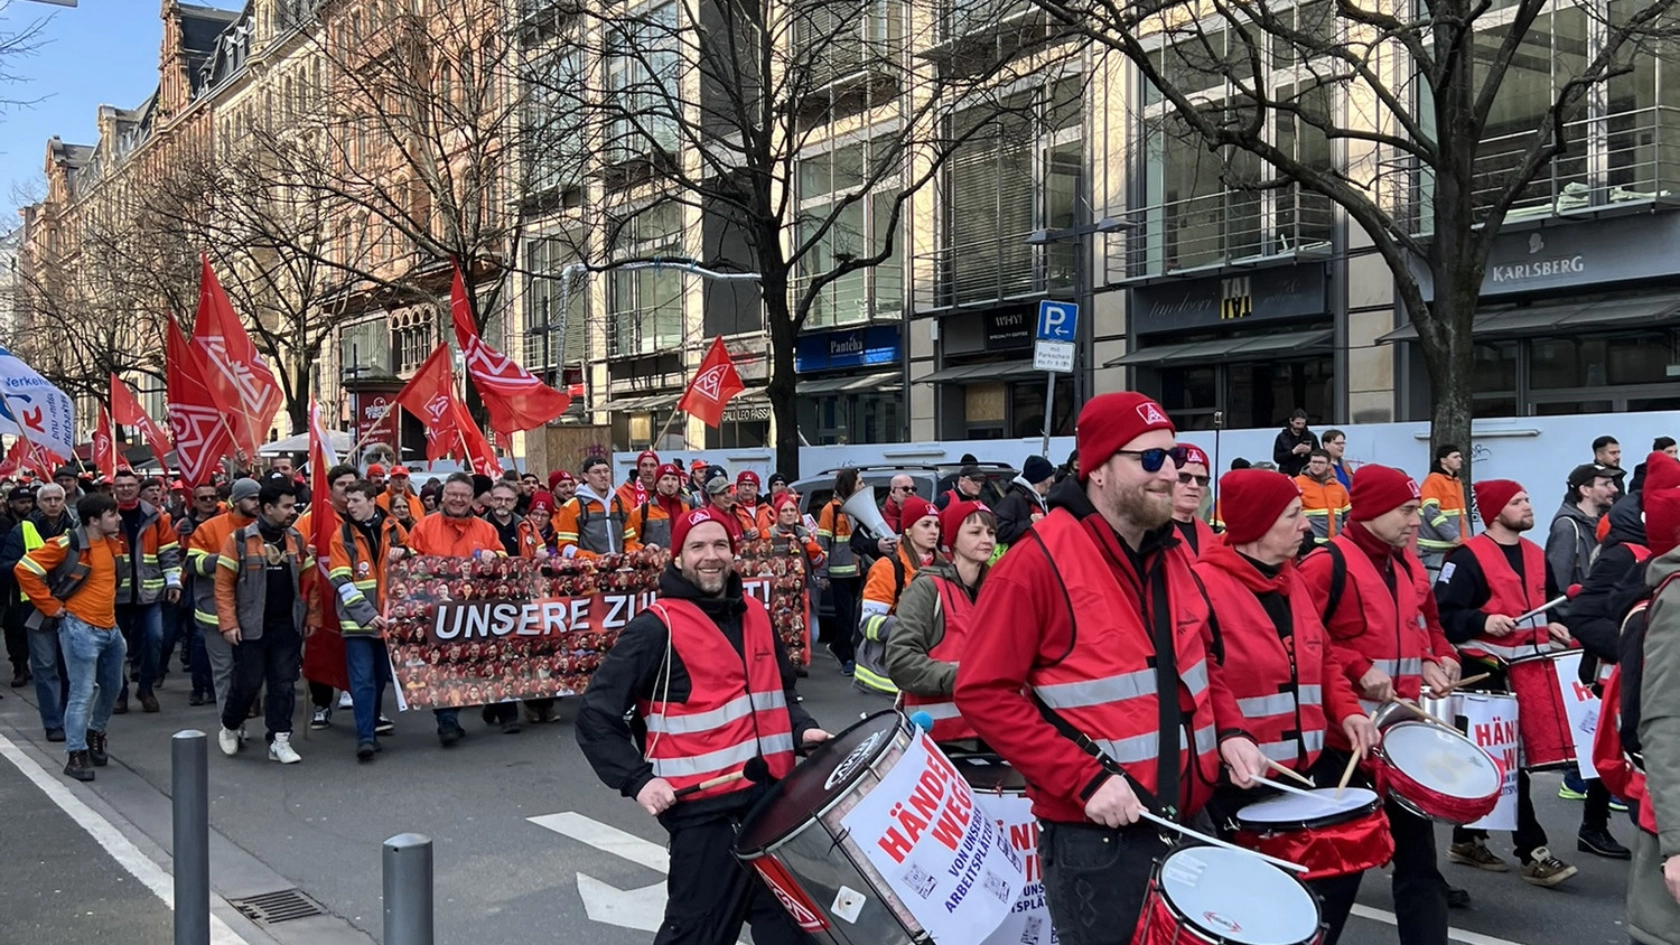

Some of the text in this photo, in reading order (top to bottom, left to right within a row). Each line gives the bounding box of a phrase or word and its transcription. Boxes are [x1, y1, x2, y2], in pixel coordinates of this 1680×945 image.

[1493, 255, 1584, 282] KARLSBERG
[1044, 306, 1066, 335] P
[751, 408, 770, 420] PASSA
[435, 598, 591, 640] UNSERE
[1474, 716, 1517, 747] HÄN
[948, 848, 969, 878] VON
